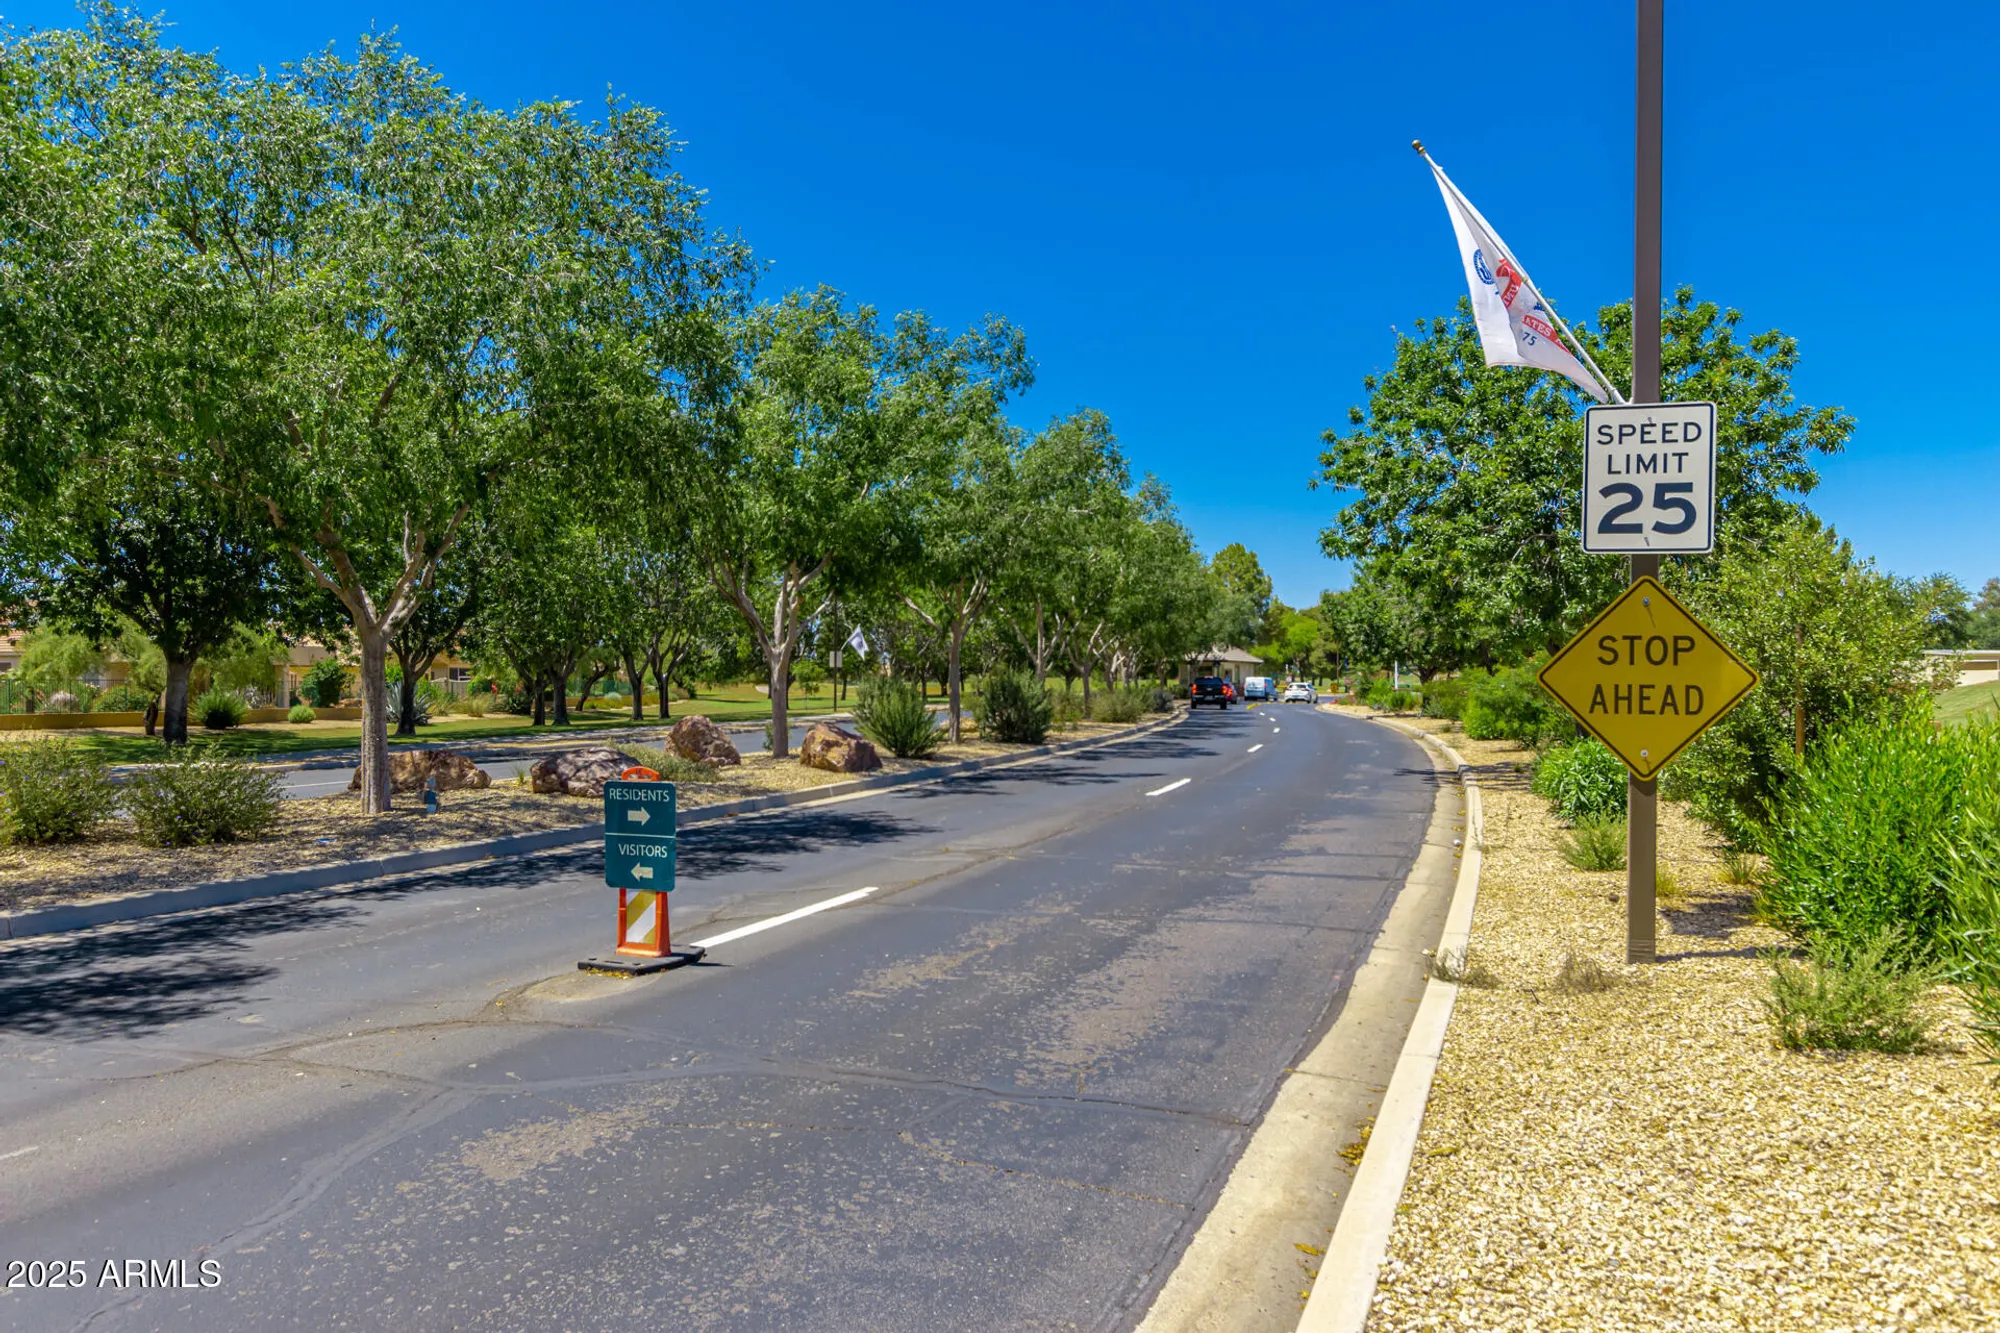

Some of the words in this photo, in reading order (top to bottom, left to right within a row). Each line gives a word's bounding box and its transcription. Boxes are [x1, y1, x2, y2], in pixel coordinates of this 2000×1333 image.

[1522, 332, 1537, 346] 75
[1596, 421, 1702, 445] SPEED
[1607, 452, 1689, 475] LIMIT
[1597, 482, 1698, 535] 25
[1597, 635, 1696, 667] STOP
[1588, 683, 1704, 715] AHEAD
[609, 788, 670, 802] RESIDENTS
[618, 843, 668, 858] VISITORS
